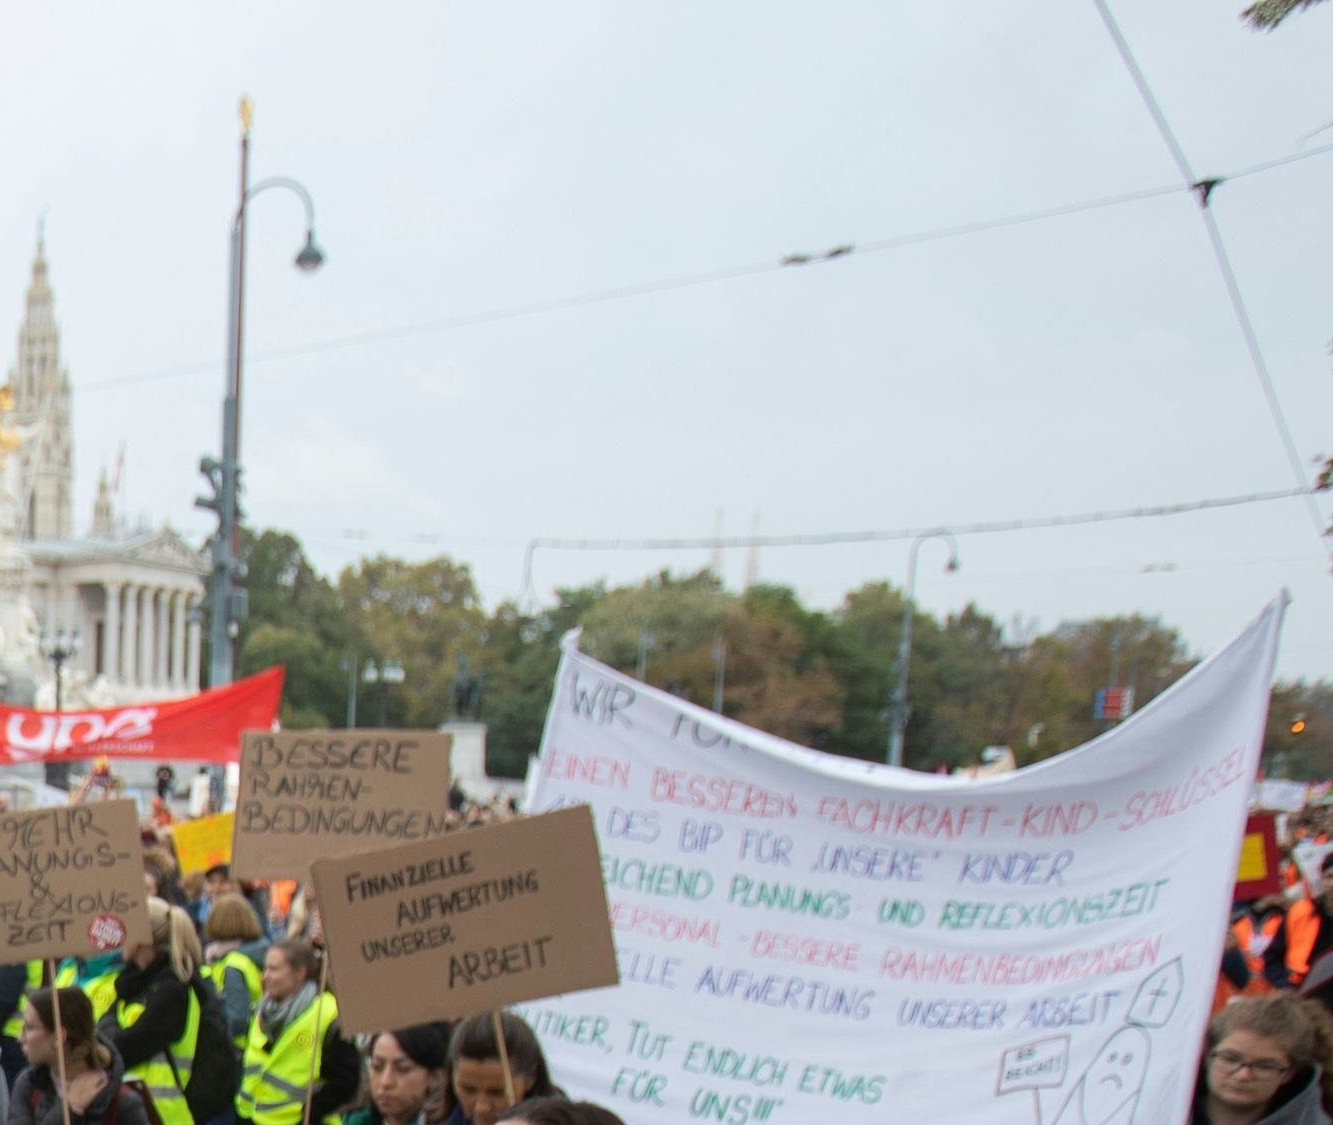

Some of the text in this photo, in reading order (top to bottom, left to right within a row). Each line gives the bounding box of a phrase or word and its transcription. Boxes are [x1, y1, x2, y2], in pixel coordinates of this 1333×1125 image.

[570, 671, 637, 730] WIR
[251, 736, 420, 774] BESSERE
[249, 769, 373, 801] RAHMEN-
[545, 747, 631, 790] EINEN
[649, 767, 798, 818] BESSEREN
[3, 807, 109, 850] MEHR
[241, 801, 447, 839] BEDINGUNGEN
[607, 806, 662, 844] DES
[678, 817, 724, 854] BIP
[737, 827, 795, 867] FÜR
[957, 847, 1075, 886] KINDER
[346, 851, 475, 904] FINANZIELLE
[397, 869, 539, 929] AUFWERTUNG
[878, 898, 926, 928] UND
[936, 877, 1170, 930] REFLEXIONSZEIT
[7, 919, 74, 947] ZEIT
[361, 923, 456, 963] UNSERER
[448, 935, 553, 990] ARBEIT
[694, 965, 875, 1022] AUFWERTUNG
[897, 997, 1007, 1030] UNSERER
[1014, 989, 1122, 1030] ARBEIT
[611, 1067, 669, 1107] FÜR
[627, 1019, 674, 1062] TUT
[682, 1041, 789, 1087] ENDLICH
[797, 1064, 889, 1105] ETWAS
